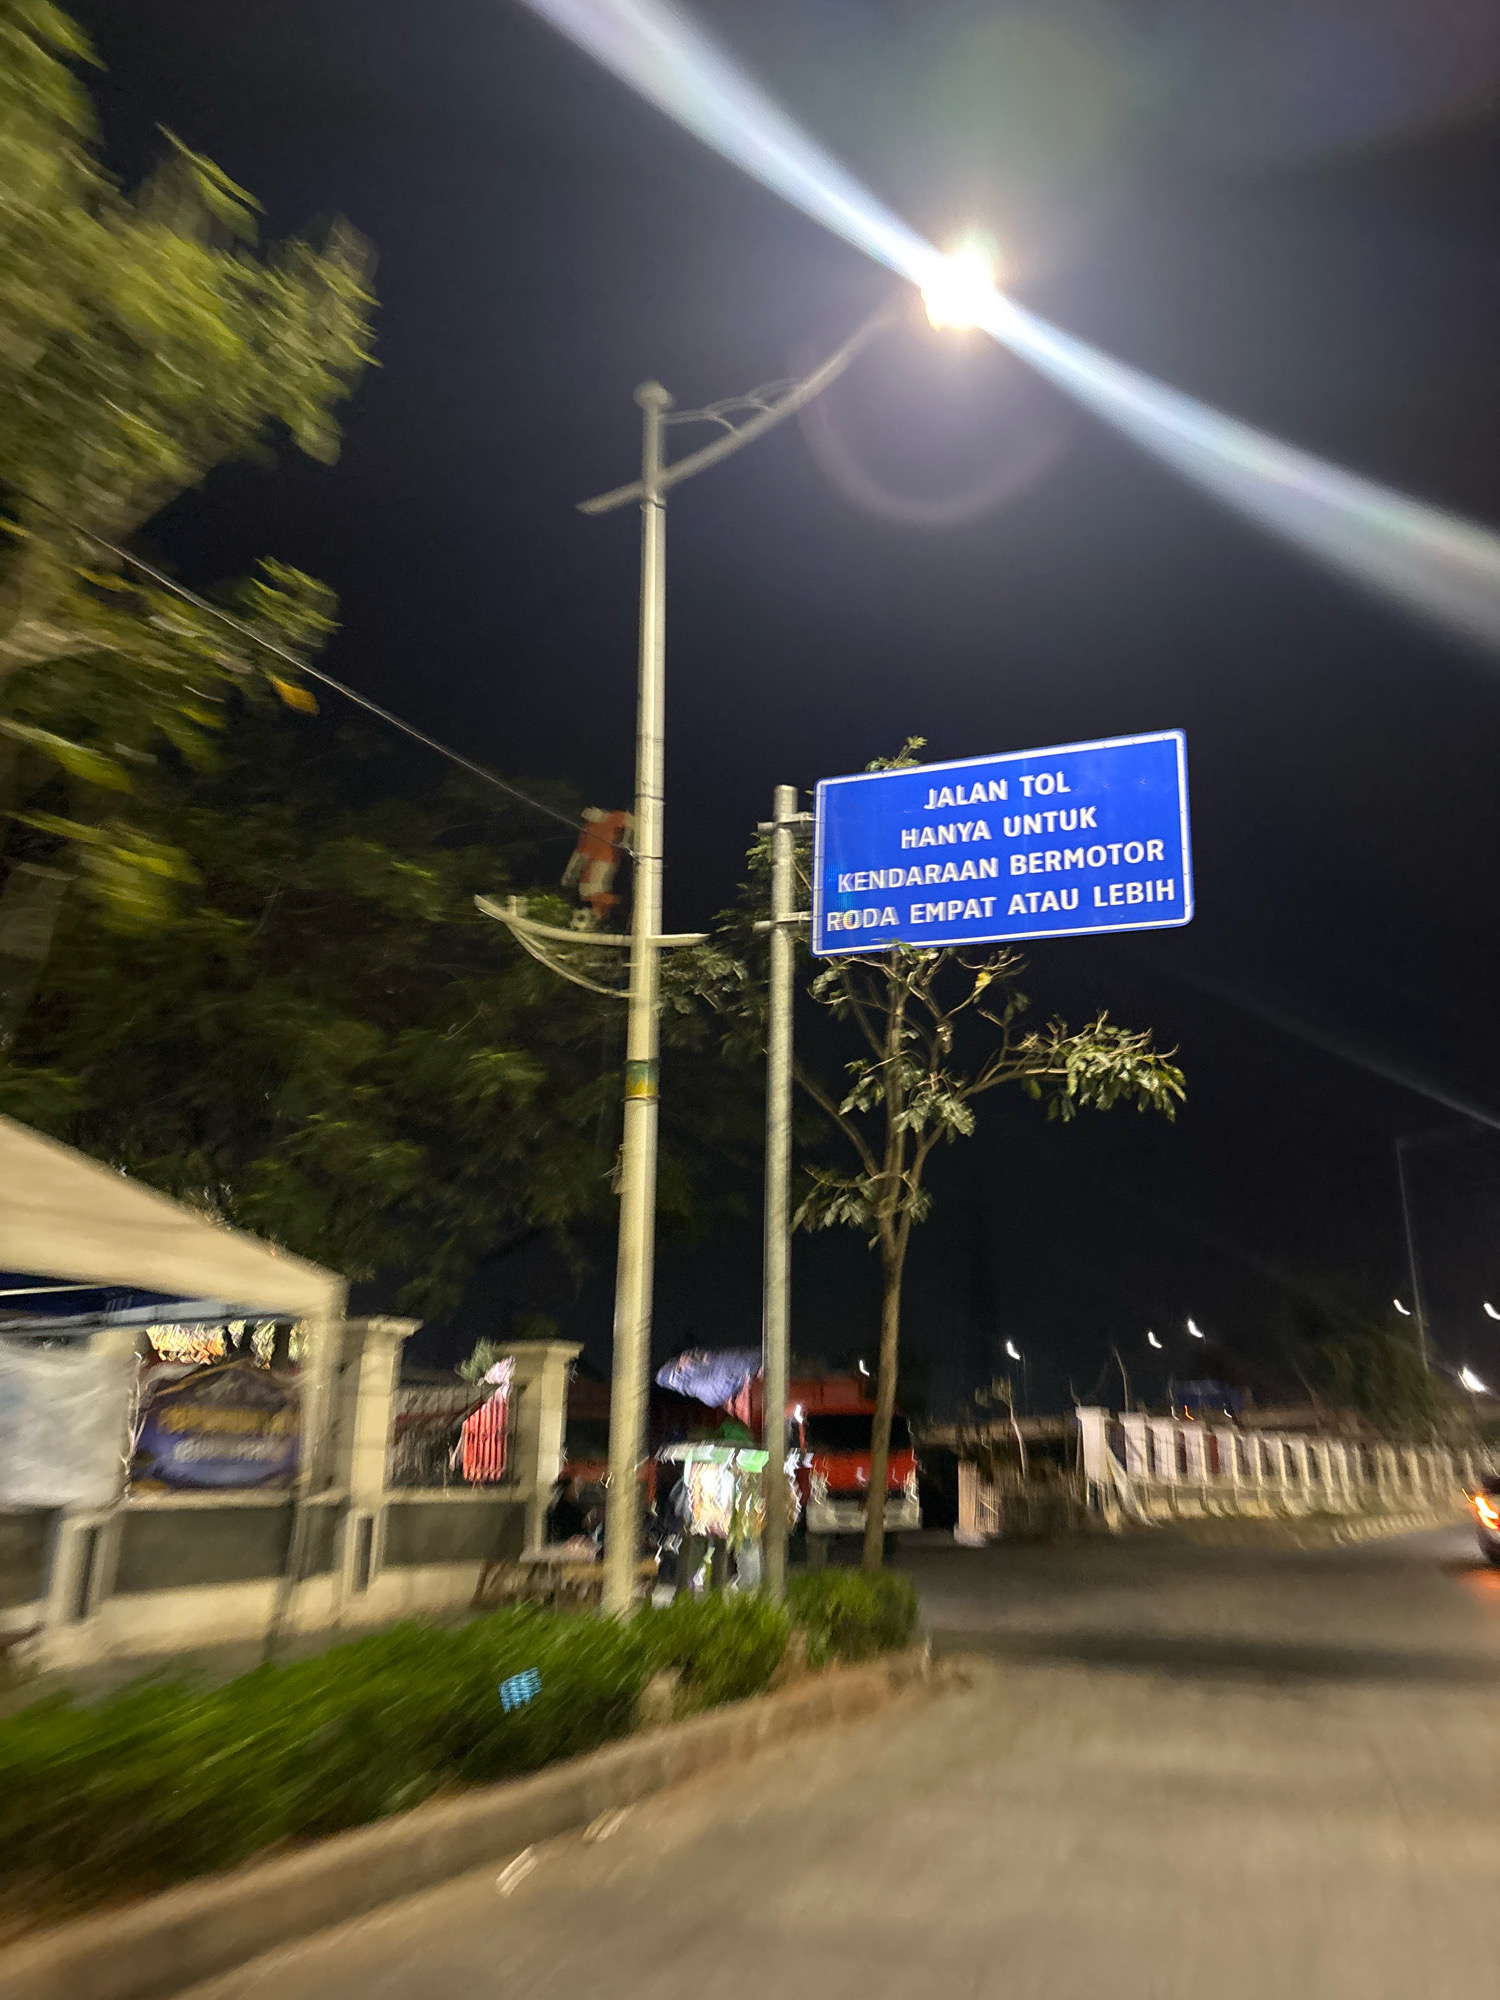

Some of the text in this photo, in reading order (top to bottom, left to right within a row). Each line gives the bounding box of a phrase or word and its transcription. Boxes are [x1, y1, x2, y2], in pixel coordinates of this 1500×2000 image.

[923, 770, 1071, 810] JALAN TOL
[900, 806, 1098, 849] HANYA UNTUK
[837, 839, 1165, 893] KENDARAAN BERMOTOR
[826, 878, 1175, 932] RODA EMPAT ATAU LEBIH
